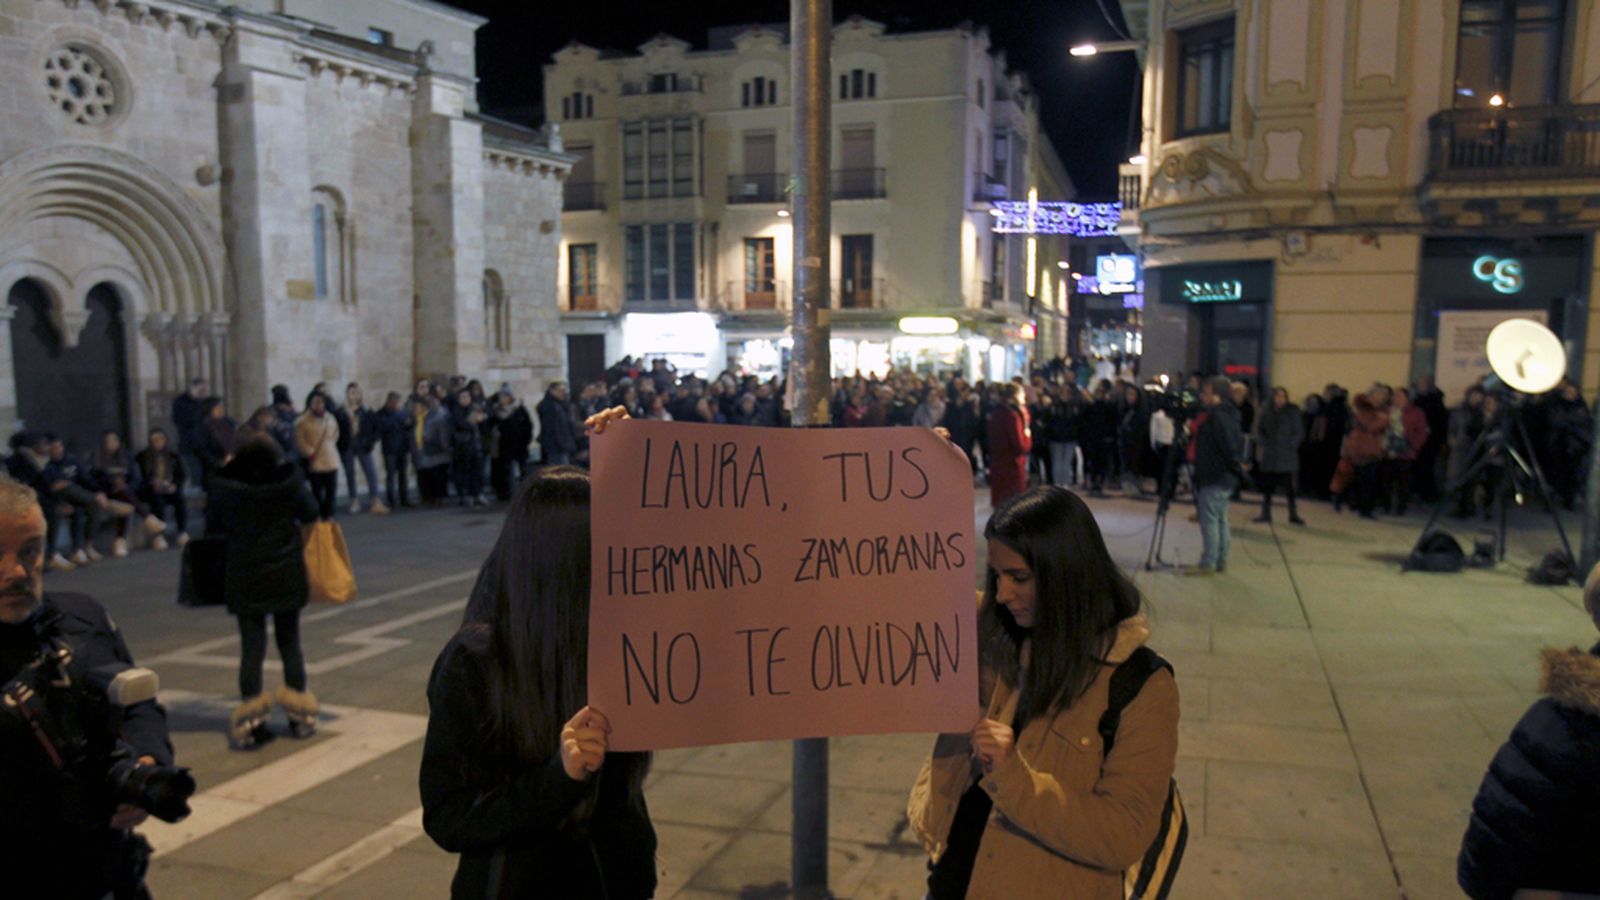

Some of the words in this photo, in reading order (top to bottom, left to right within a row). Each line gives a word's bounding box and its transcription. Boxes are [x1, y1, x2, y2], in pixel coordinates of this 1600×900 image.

[641, 437, 788, 512] LAURA,
[823, 447, 929, 502] TUS
[607, 543, 762, 596] HERMANAS
[794, 531, 966, 583] ZAMORANAS
[622, 630, 700, 706] NO
[735, 626, 791, 697] TE
